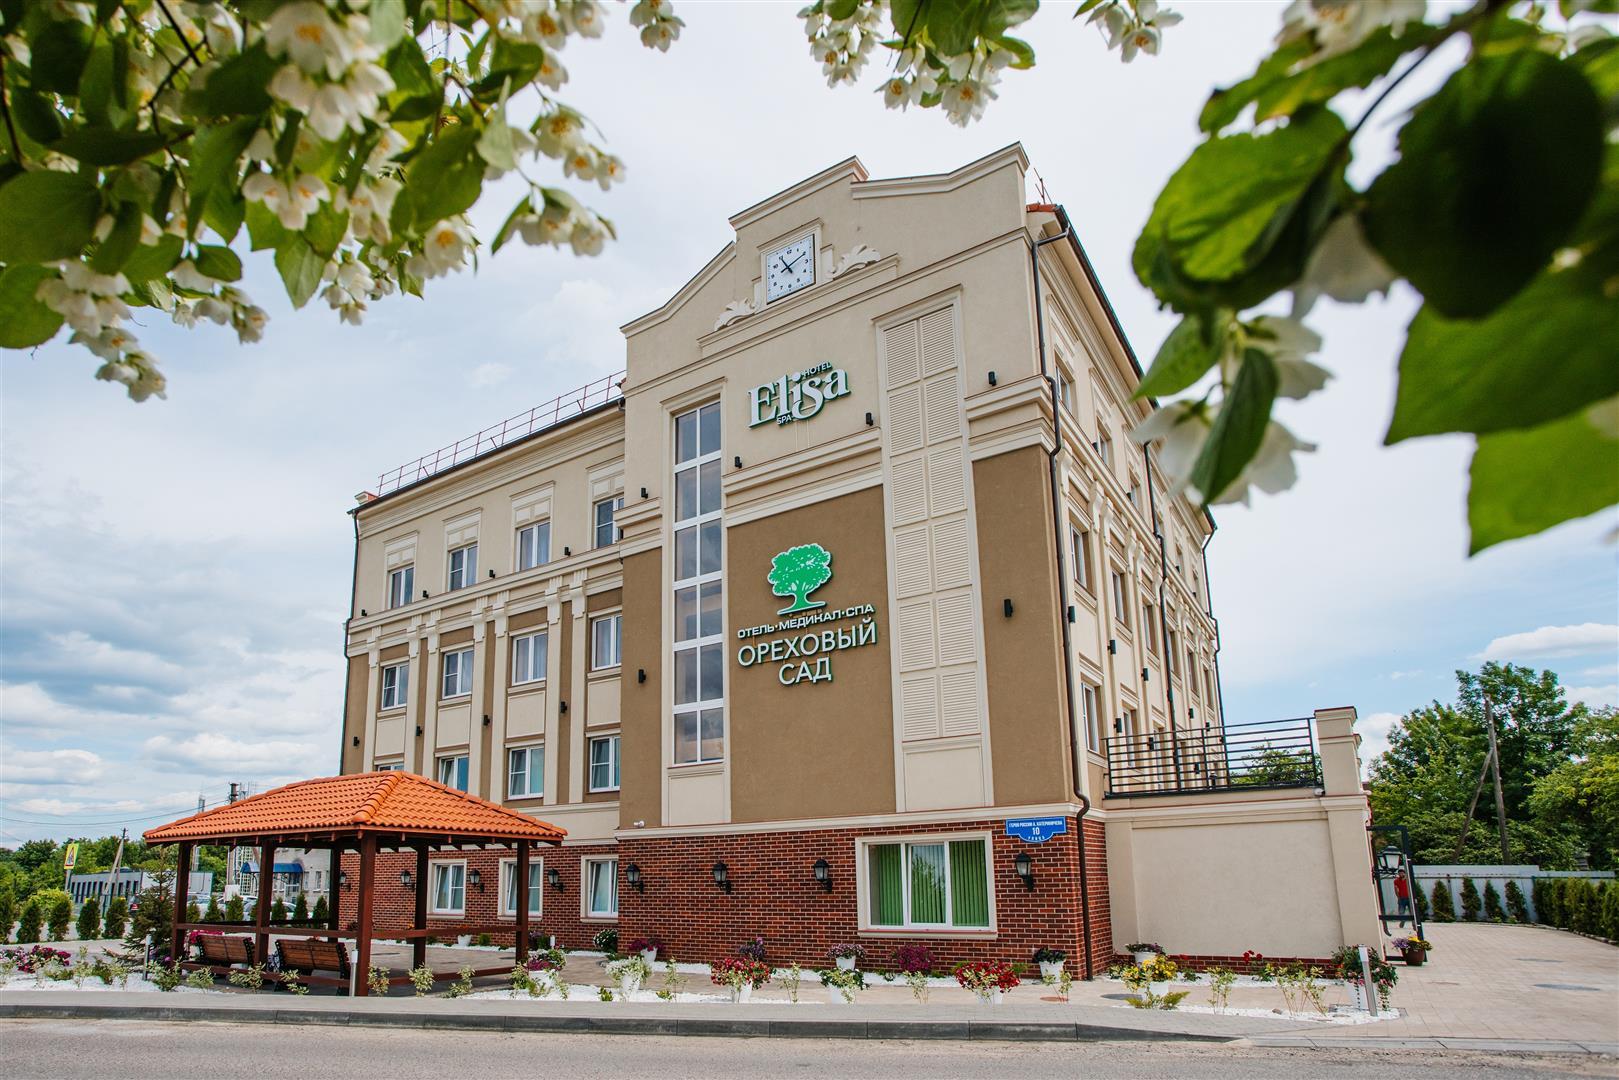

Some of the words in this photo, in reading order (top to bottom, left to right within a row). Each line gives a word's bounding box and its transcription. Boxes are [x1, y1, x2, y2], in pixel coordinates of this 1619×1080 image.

[803, 361, 833, 378] HOTEL
[748, 368, 851, 429] Elisa
[777, 414, 792, 427] SPA
[737, 616, 878, 667] ОРЕХОВЫЙ
[778, 656, 833, 685] САД
[1032, 827, 1040, 835] 10
